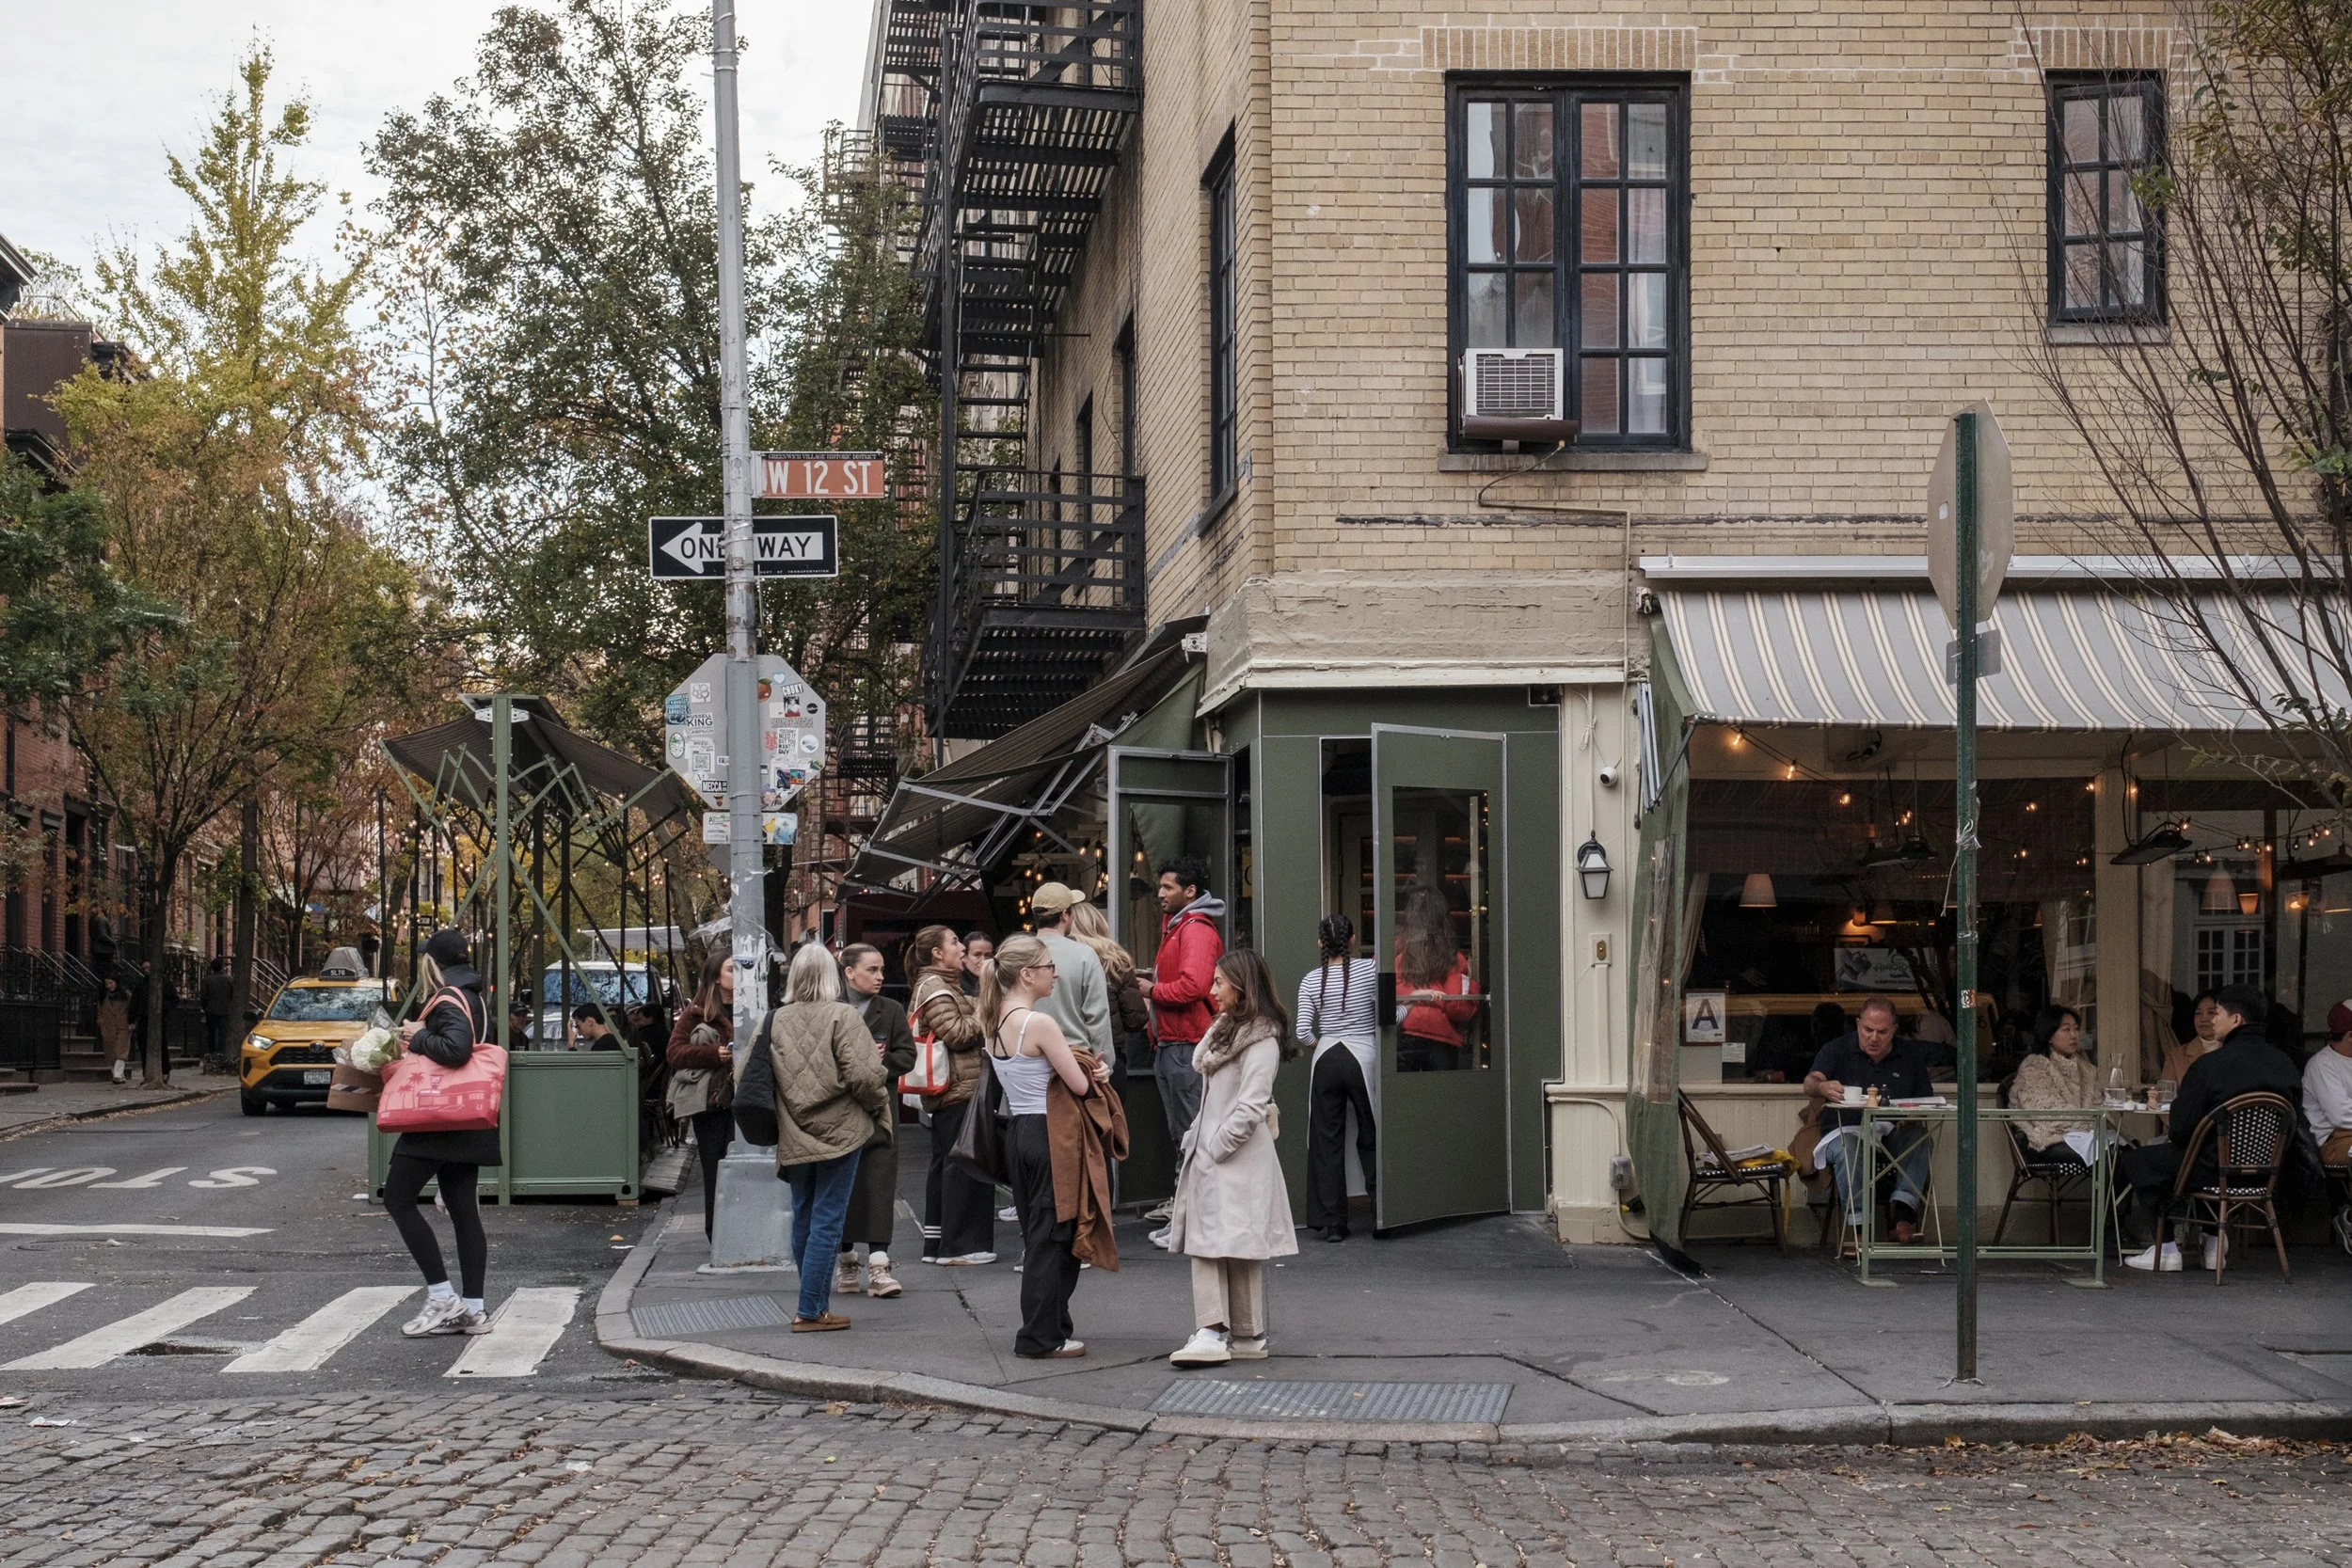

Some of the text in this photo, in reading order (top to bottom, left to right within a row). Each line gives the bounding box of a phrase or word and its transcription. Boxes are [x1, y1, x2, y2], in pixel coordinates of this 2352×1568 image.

[768, 460, 871, 495] W 12 ST
[757, 535, 812, 558] WAY
[687, 718, 713, 726] KING
[702, 781, 723, 792] MECCA
[1691, 999, 1720, 1030] A
